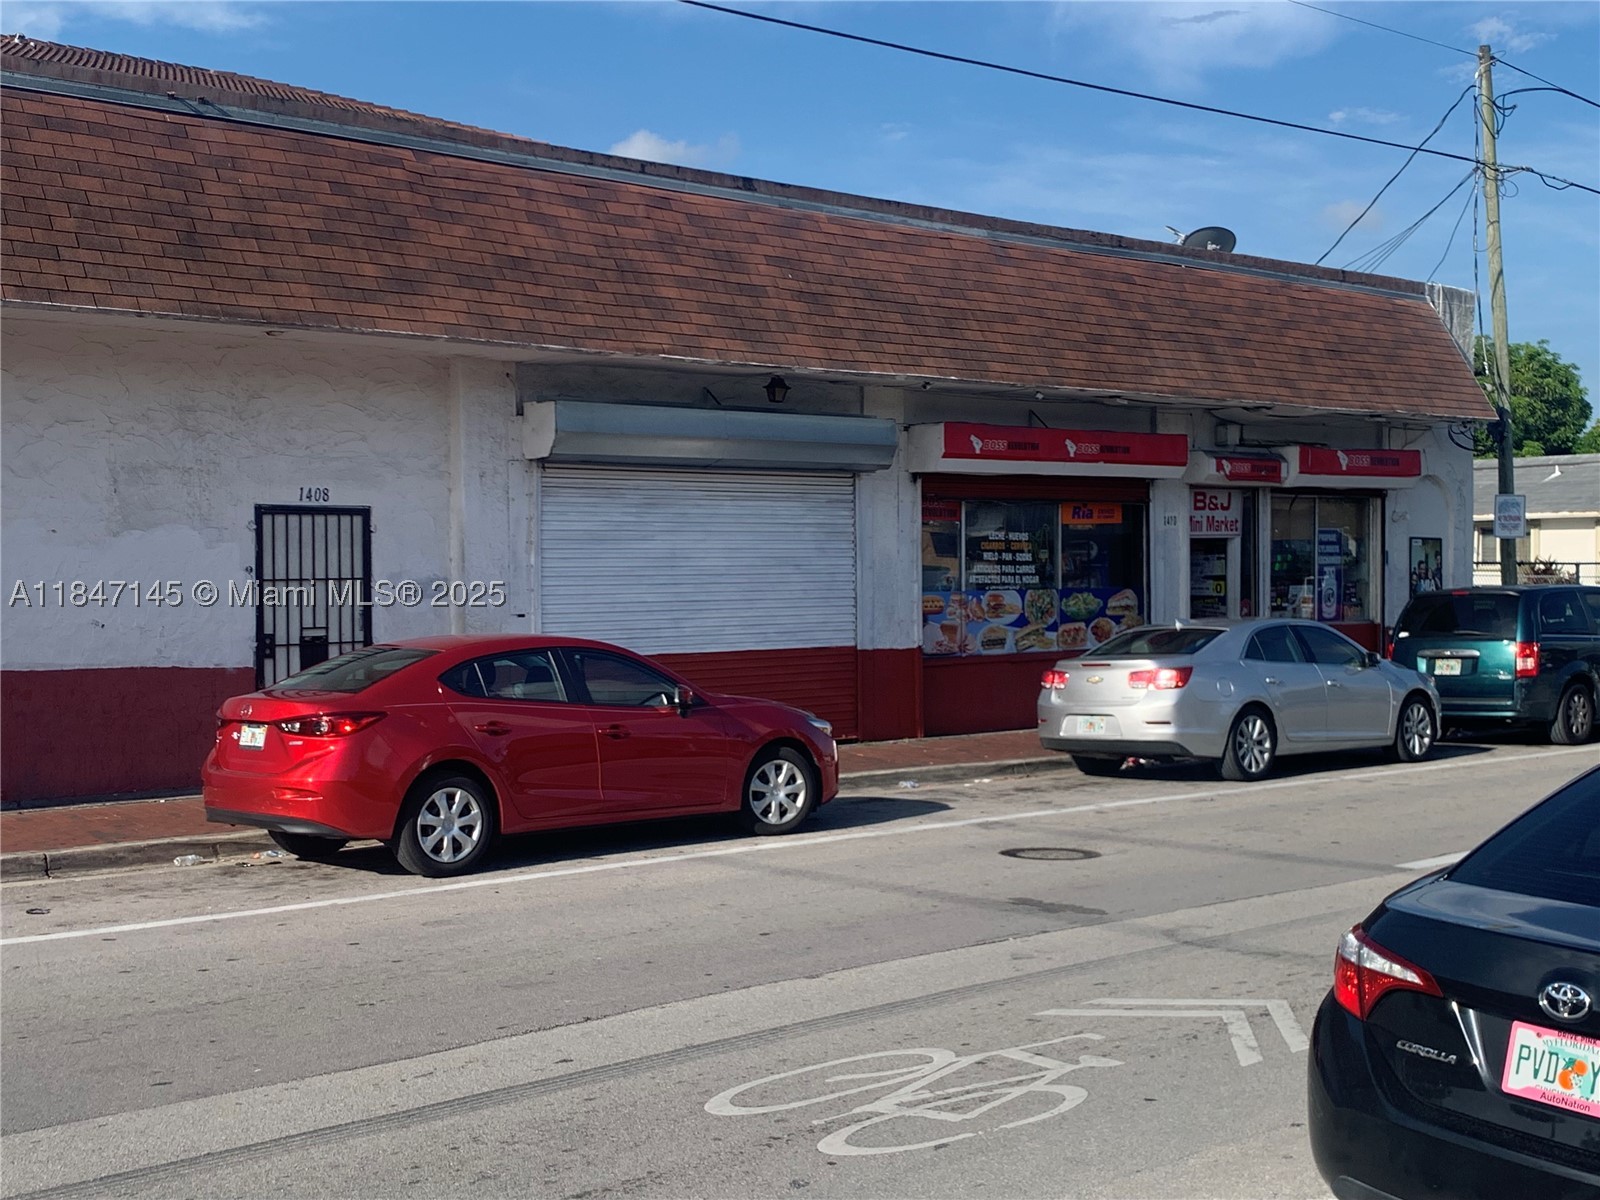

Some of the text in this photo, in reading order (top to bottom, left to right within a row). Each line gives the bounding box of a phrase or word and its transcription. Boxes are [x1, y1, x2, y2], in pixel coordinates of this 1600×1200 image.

[983, 440, 1008, 451] BOSS
[1076, 443, 1100, 454] BOSS
[1231, 462, 1251, 473] BOSS
[1348, 454, 1370, 466] BOSS
[299, 487, 330, 502] 1408
[1194, 491, 1231, 511] B&J
[1072, 503, 1093, 520] Ria
[1206, 515, 1239, 532] Market
[1002, 553, 1012, 561] PAN
[1002, 565, 1015, 573] PARA
[1016, 565, 1036, 574] CARROS
[1001, 575, 1014, 584] PARA
[1015, 575, 1022, 584] EL
[1557, 1031, 1598, 1047] DRIVE PINK
[1396, 1040, 1457, 1065] COROLLA
[1515, 1044, 1560, 1084] PVD
[1539, 1091, 1591, 1112] AutoNation
